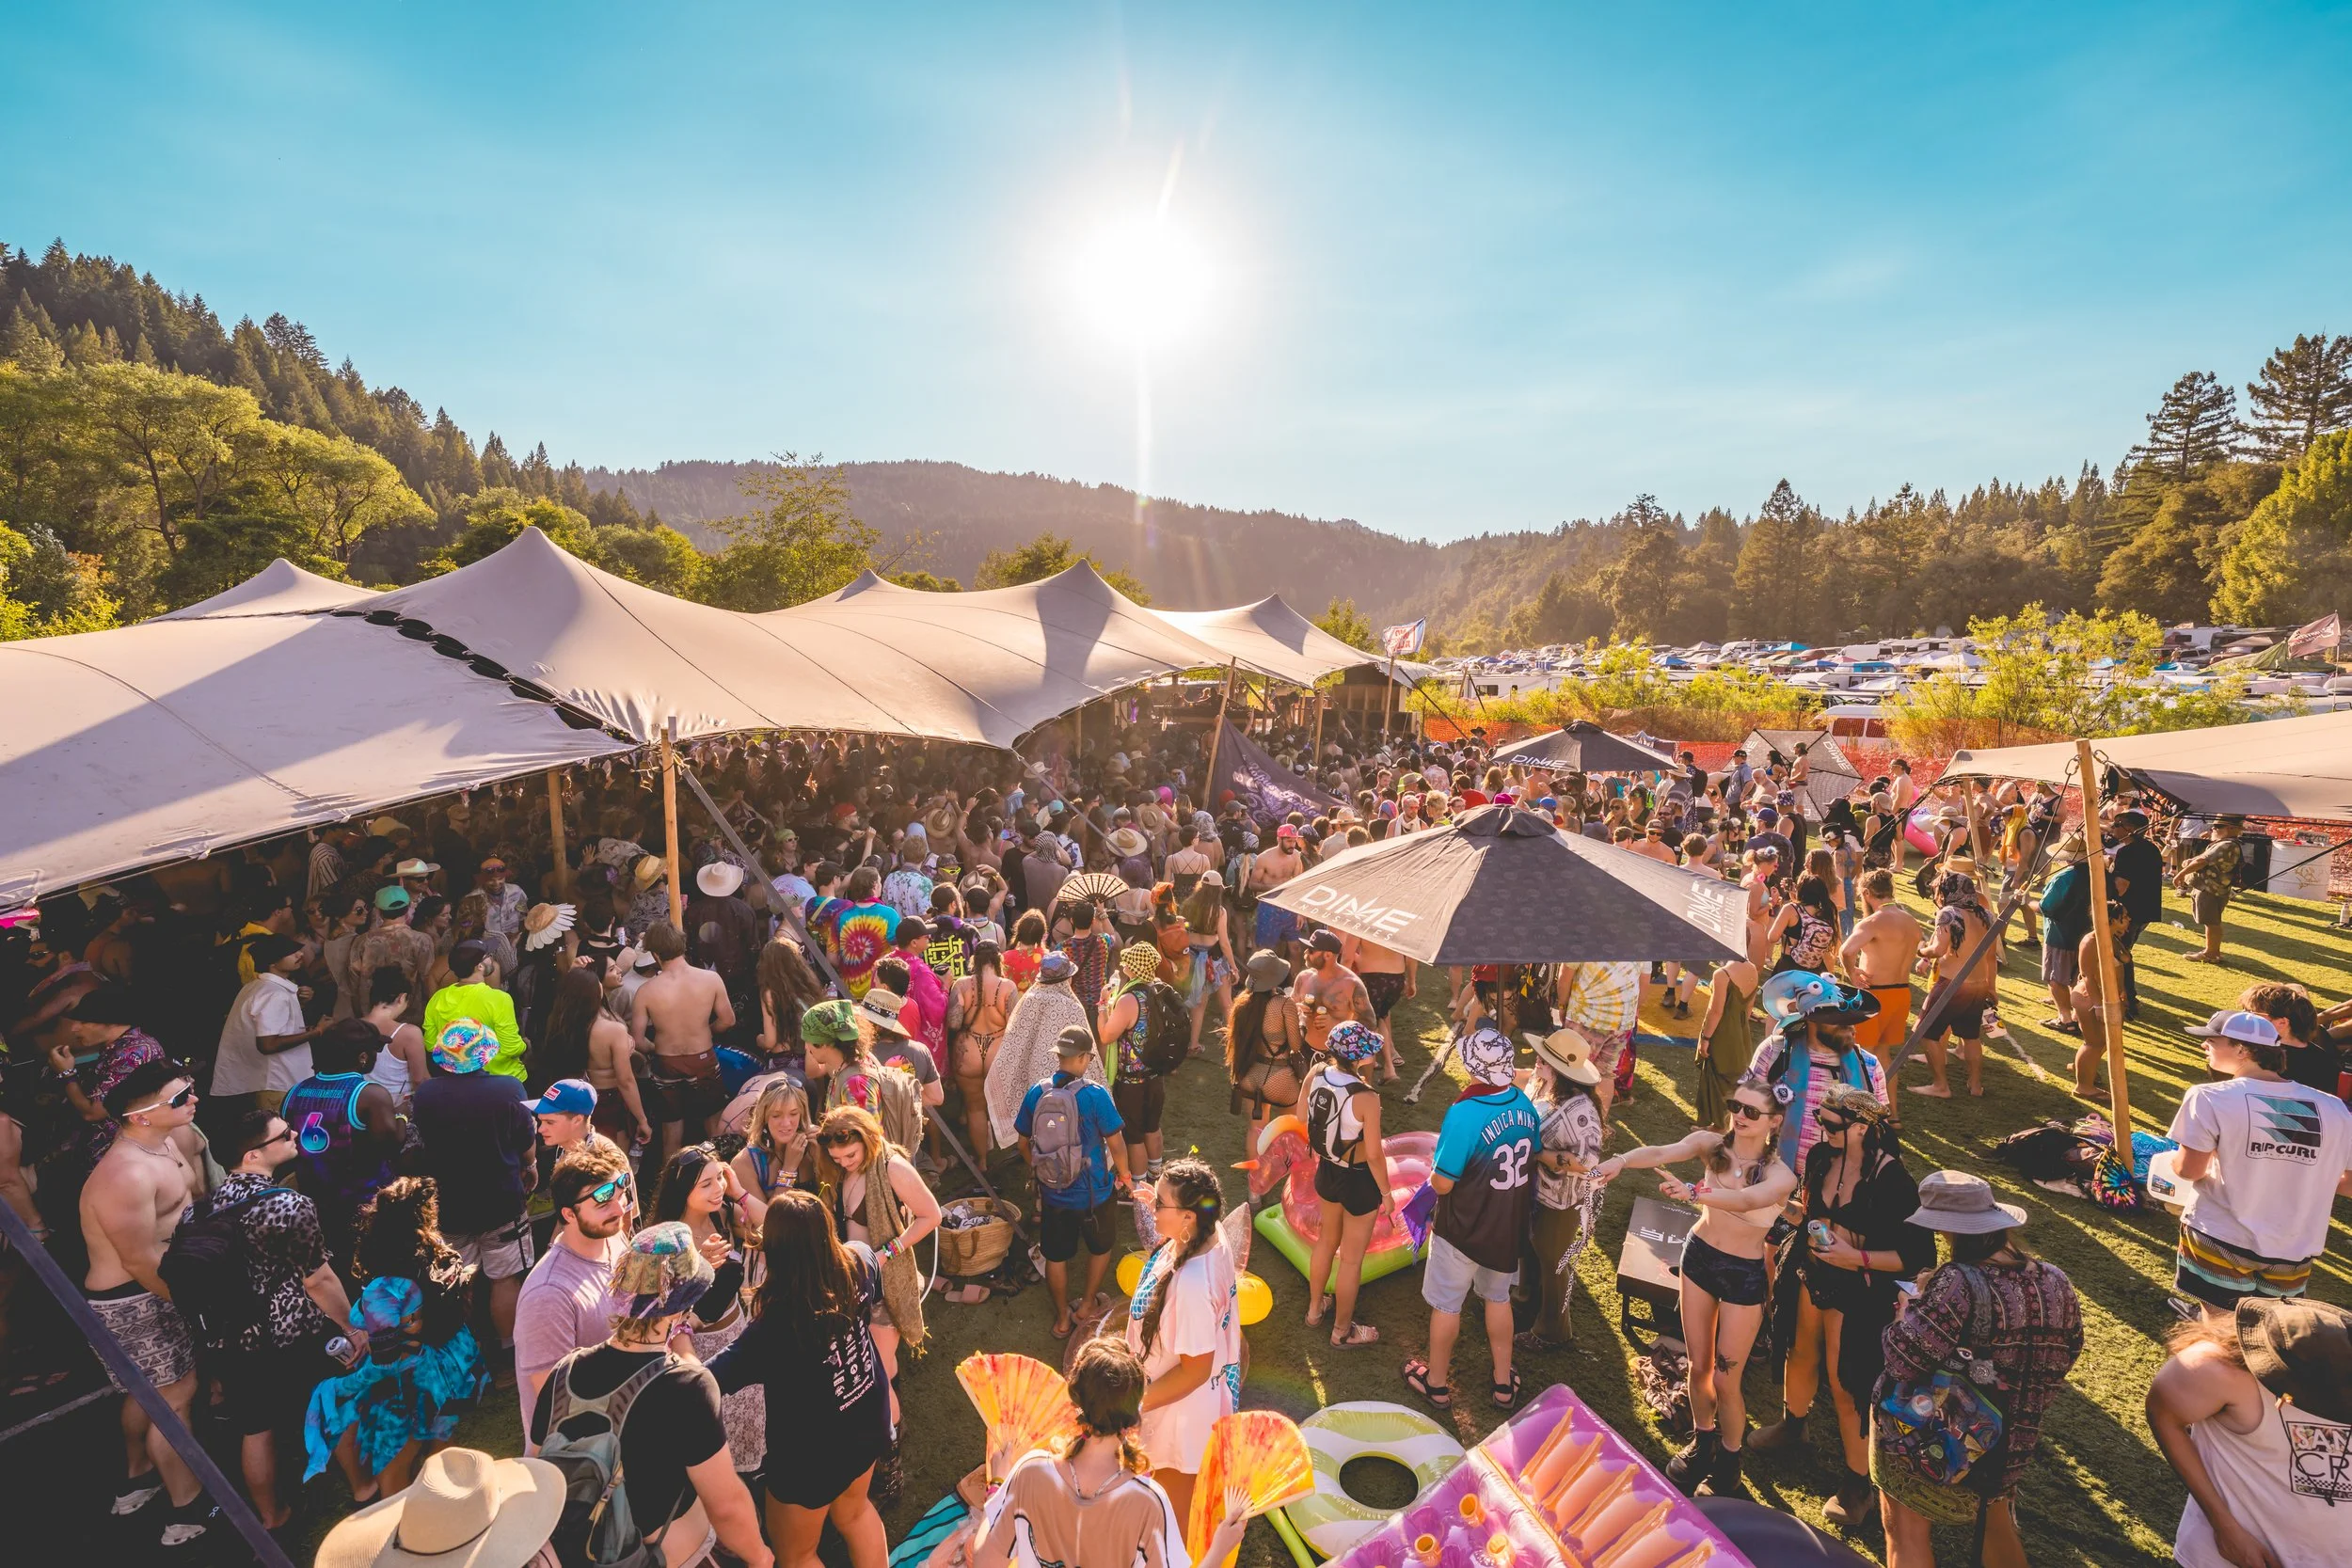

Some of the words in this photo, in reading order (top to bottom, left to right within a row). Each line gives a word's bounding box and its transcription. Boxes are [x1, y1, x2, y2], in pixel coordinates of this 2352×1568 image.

[1510, 754, 1567, 768] DIME
[1291, 900, 1394, 942] INDUSTRIES
[1299, 884, 1418, 933] DIME
[1682, 880, 1724, 934] DIME
[299, 1112, 330, 1153] 6
[1481, 1110, 1515, 1146] INDICA
[1489, 1137, 1532, 1191] 32
[2250, 1141, 2275, 1152] RIP
[2275, 1145, 2317, 1159] CURL
